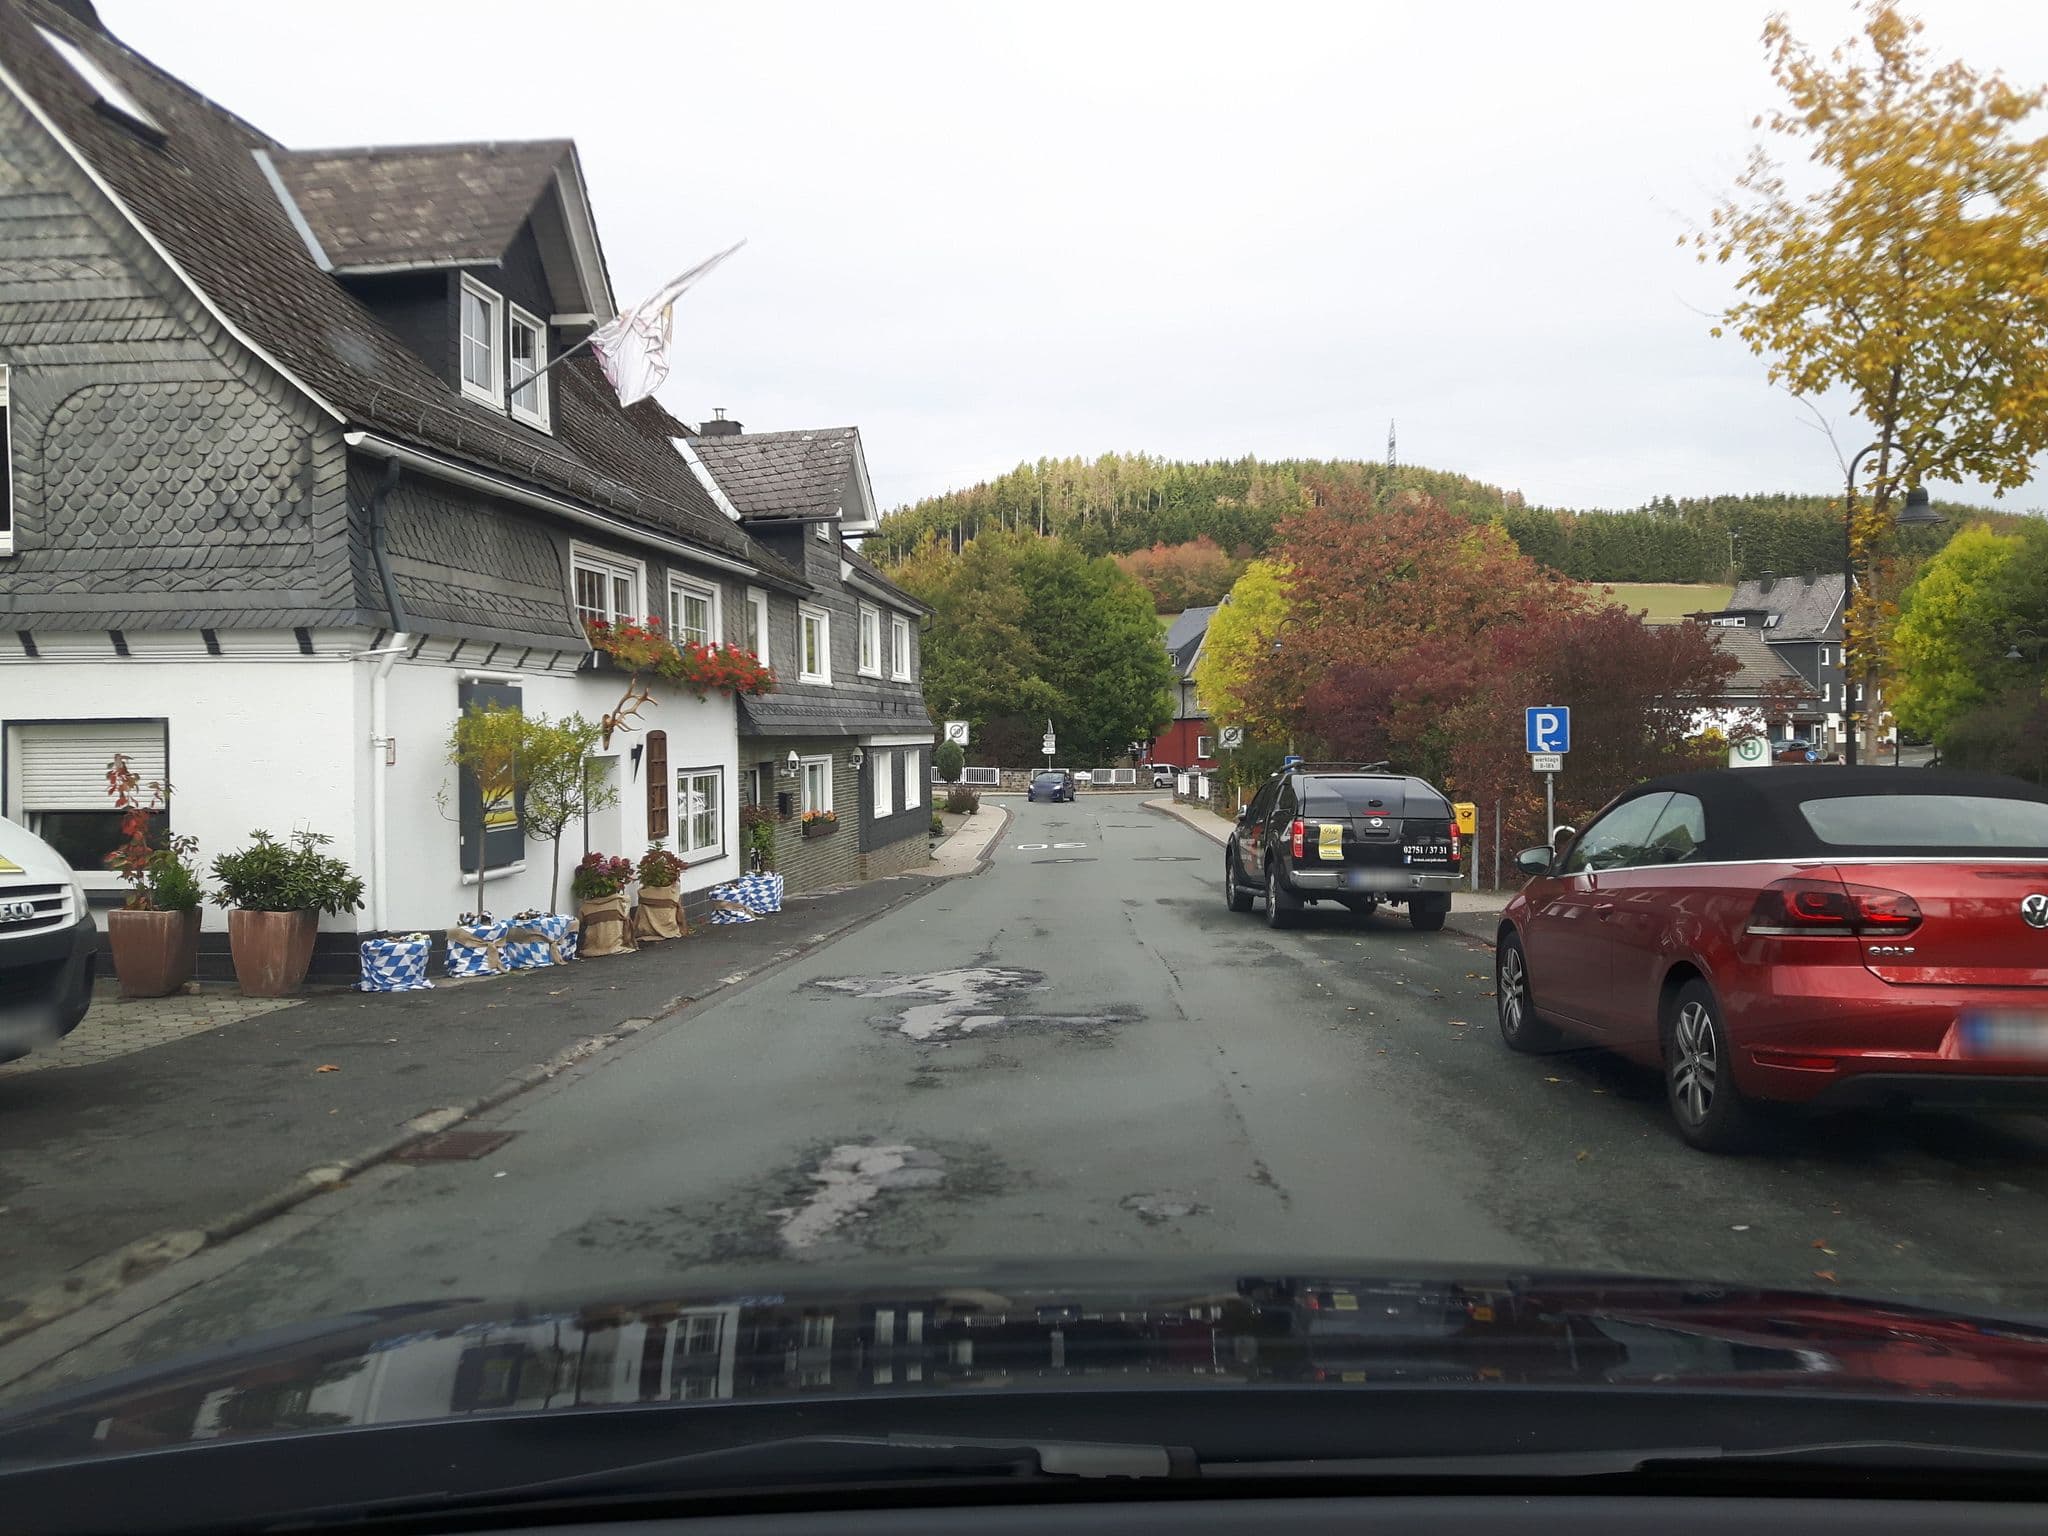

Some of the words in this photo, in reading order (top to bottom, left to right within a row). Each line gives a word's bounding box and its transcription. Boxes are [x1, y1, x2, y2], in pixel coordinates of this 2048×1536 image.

[1536, 713, 1559, 747] P
[1744, 739, 1756, 756] H
[1403, 846, 1423, 854] 02751
[1429, 846, 1438, 854] 37
[1439, 846, 1447, 855] 31
[1868, 946, 1915, 957] GOLF
